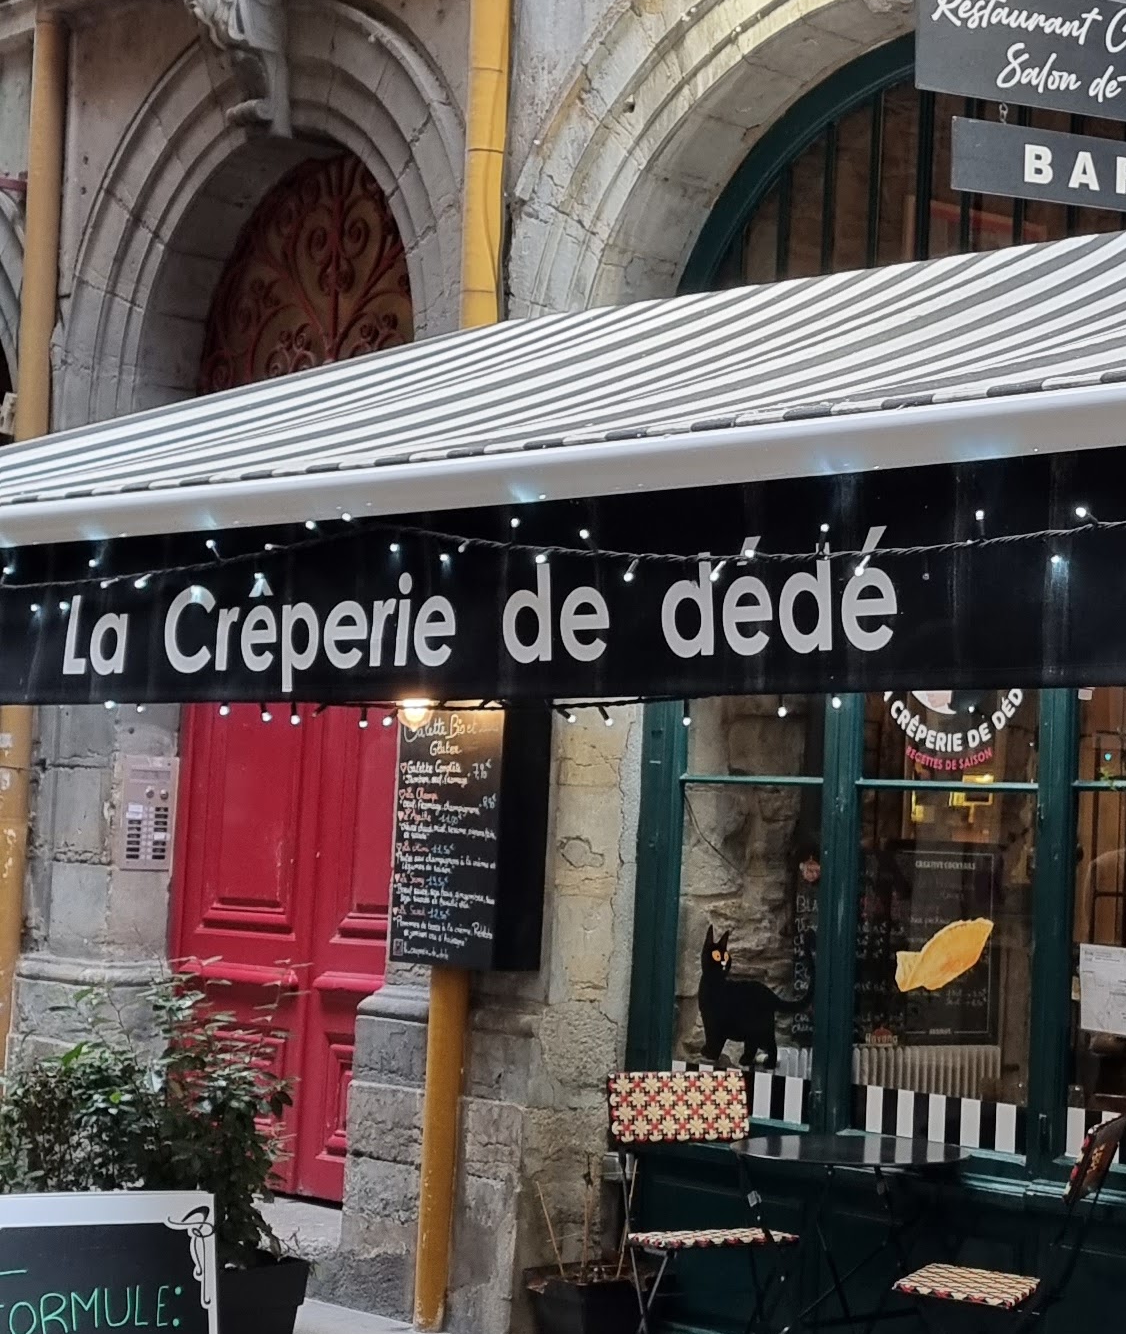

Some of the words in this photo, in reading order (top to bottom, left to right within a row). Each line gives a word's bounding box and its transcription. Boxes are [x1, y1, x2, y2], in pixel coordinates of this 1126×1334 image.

[997, 43, 1081, 93] Salon
[1088, 65, 1121, 102] de
[62, 594, 129, 675] La
[163, 572, 457, 692] Crêperie
[502, 561, 610, 664] de
[661, 525, 898, 659] dédé
[890, 700, 963, 753] CRÊPERIE
[967, 722, 992, 749] DE
[991, 688, 1024, 730] DÉD
[906, 745, 943, 770] RECETTES
[945, 759, 957, 771] DE
[959, 747, 993, 769] SAISON
